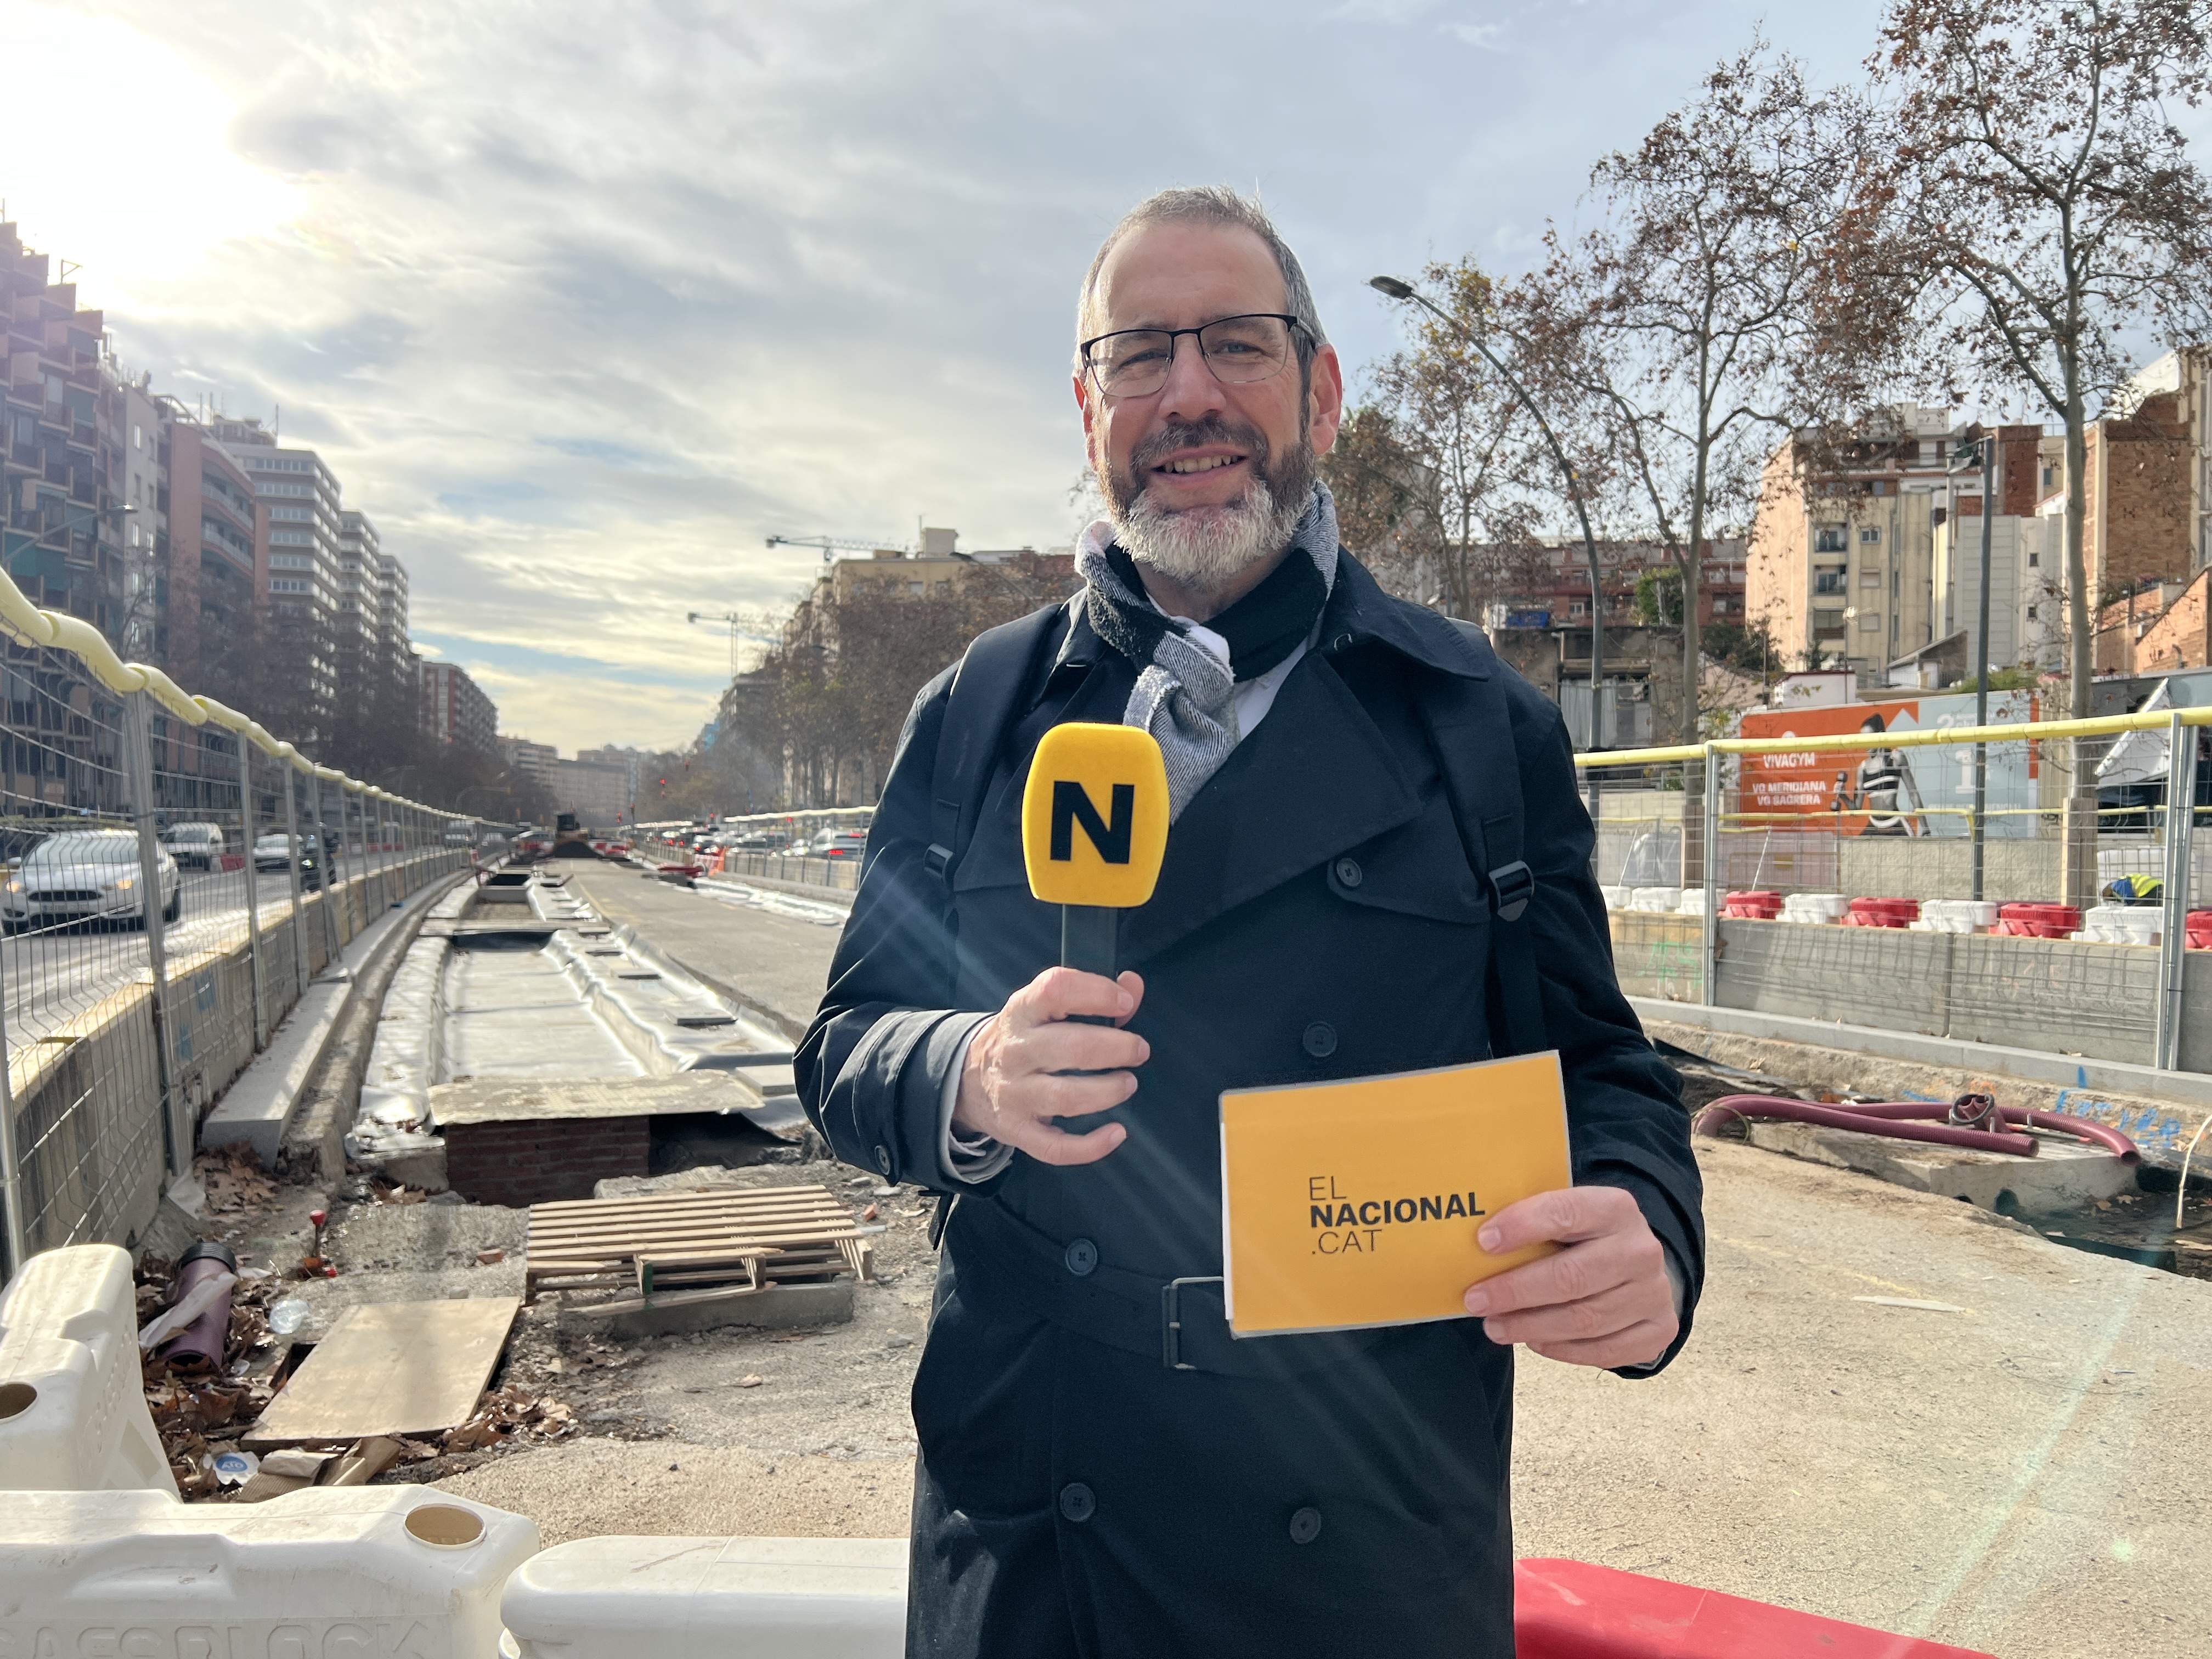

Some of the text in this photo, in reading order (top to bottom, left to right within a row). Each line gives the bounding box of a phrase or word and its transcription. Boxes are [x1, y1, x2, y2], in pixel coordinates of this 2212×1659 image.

[1763, 752, 1815, 768] VIVAGYM
[1768, 781, 1826, 792] MERIDIANA
[1050, 781, 1134, 864] N
[1309, 1176, 1347, 1200] EL
[1310, 1192, 1486, 1228] NACIONAL
[1312, 1229, 1383, 1255] .CAT
